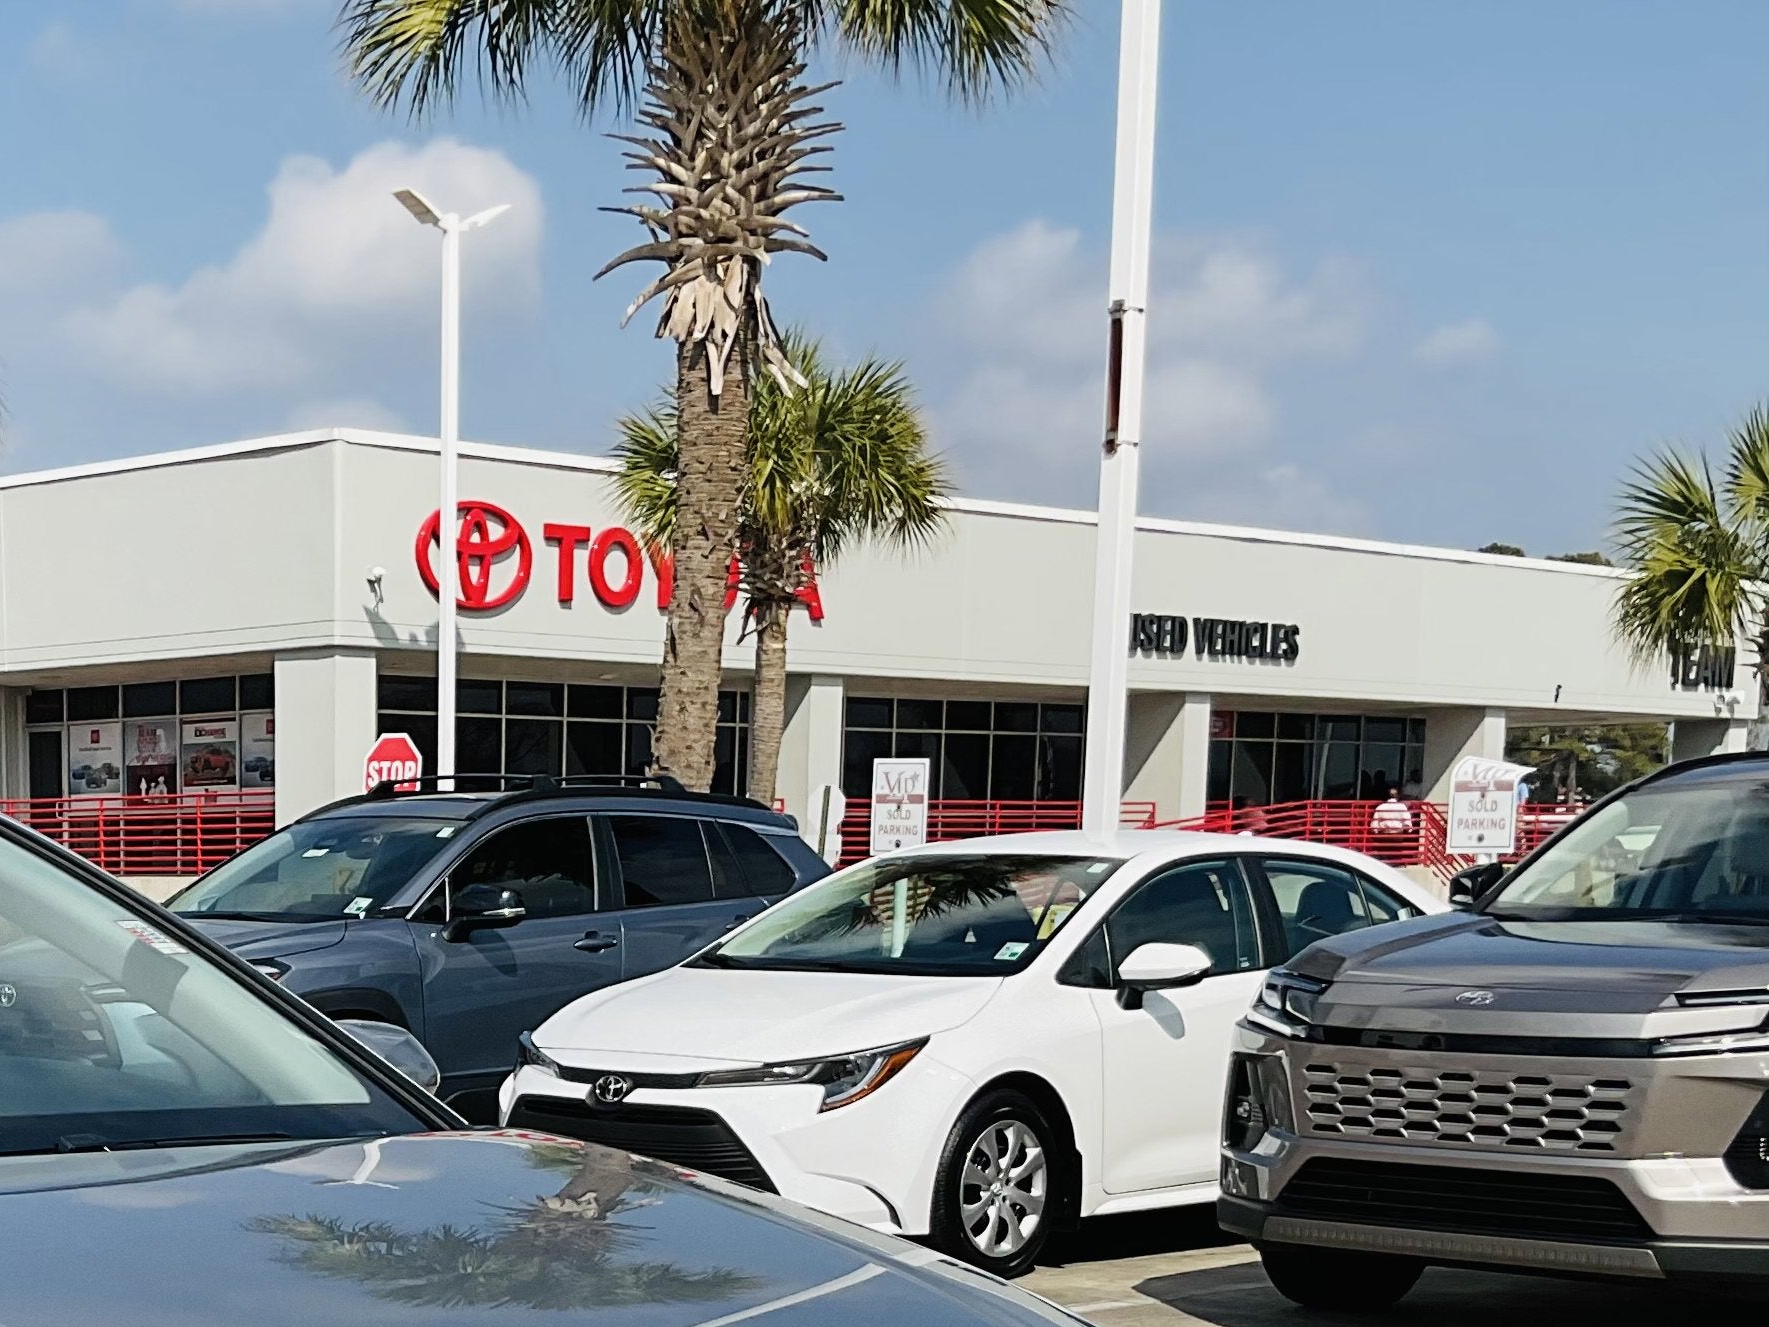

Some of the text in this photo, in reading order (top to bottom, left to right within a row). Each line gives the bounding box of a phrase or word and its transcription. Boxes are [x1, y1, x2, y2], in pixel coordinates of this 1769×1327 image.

[543, 522, 824, 620] TOY
[1129, 613, 1299, 661] USED VEHICLES
[367, 760, 417, 789] STOP
[1467, 799, 1498, 813] SOLD
[886, 809, 911, 820] SOLD
[878, 824, 919, 836] PARKING
[1457, 818, 1506, 830] PARKING
